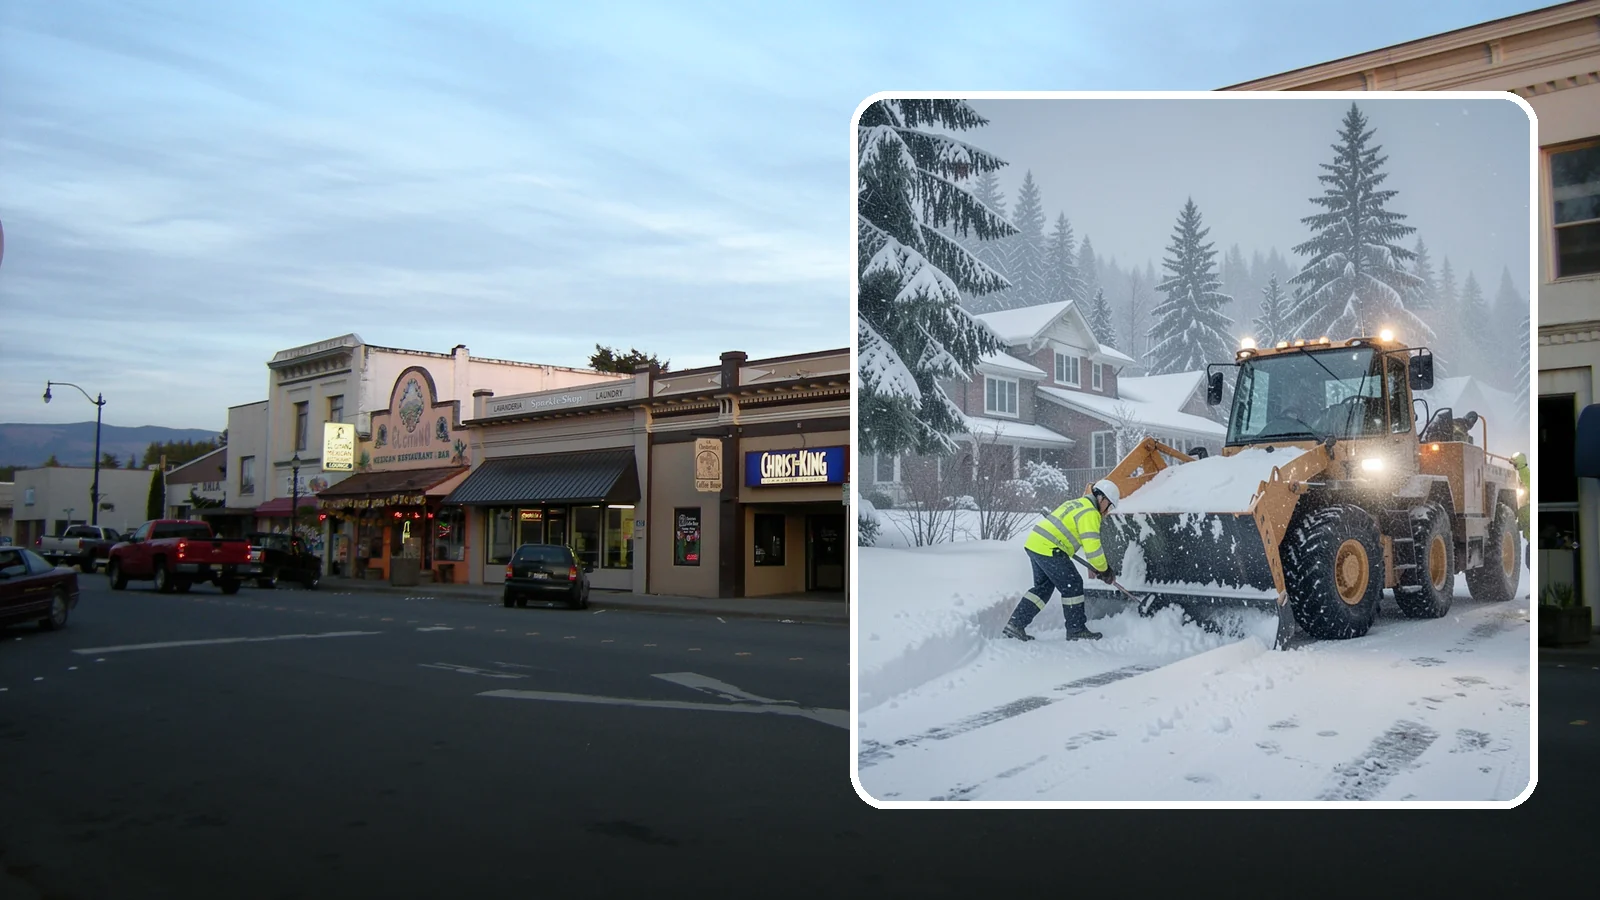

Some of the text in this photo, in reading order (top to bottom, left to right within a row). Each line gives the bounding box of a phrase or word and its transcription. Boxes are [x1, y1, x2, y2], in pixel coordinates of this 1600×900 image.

[531, 394, 582, 409] Sparkle Shop
[596, 389, 624, 400] LAUNDRY
[493, 402, 522, 412] LAVANDERIA
[373, 455, 396, 464] MEXICAN
[397, 451, 433, 462] RESTAURANT
[438, 450, 450, 459] BAR
[799, 450, 828, 476] KING
